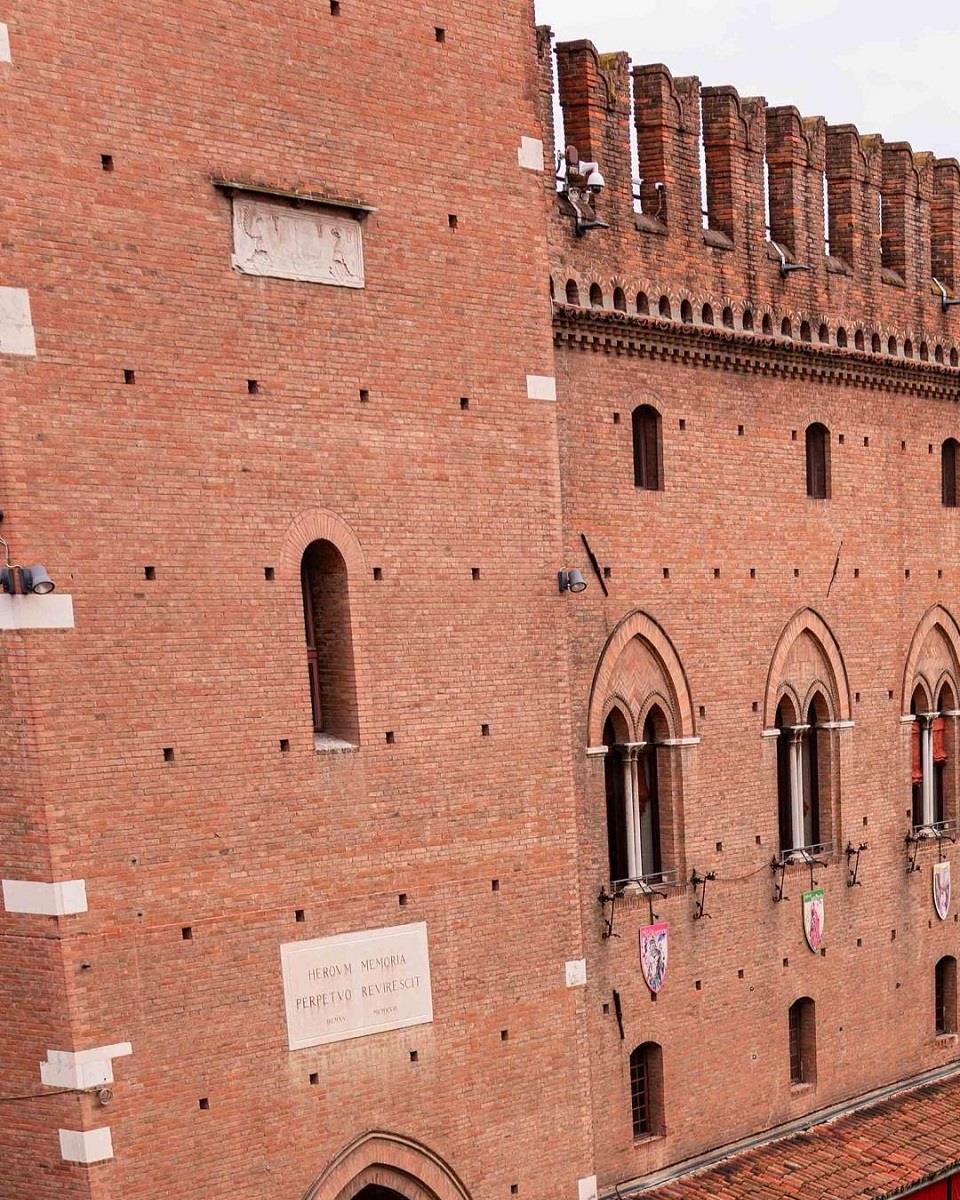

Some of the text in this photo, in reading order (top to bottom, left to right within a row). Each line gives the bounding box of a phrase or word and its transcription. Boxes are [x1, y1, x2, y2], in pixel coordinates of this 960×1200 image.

[360, 954, 407, 973] MEMORIA
[296, 975, 421, 1010] PERPETVO REVIRESCIT
